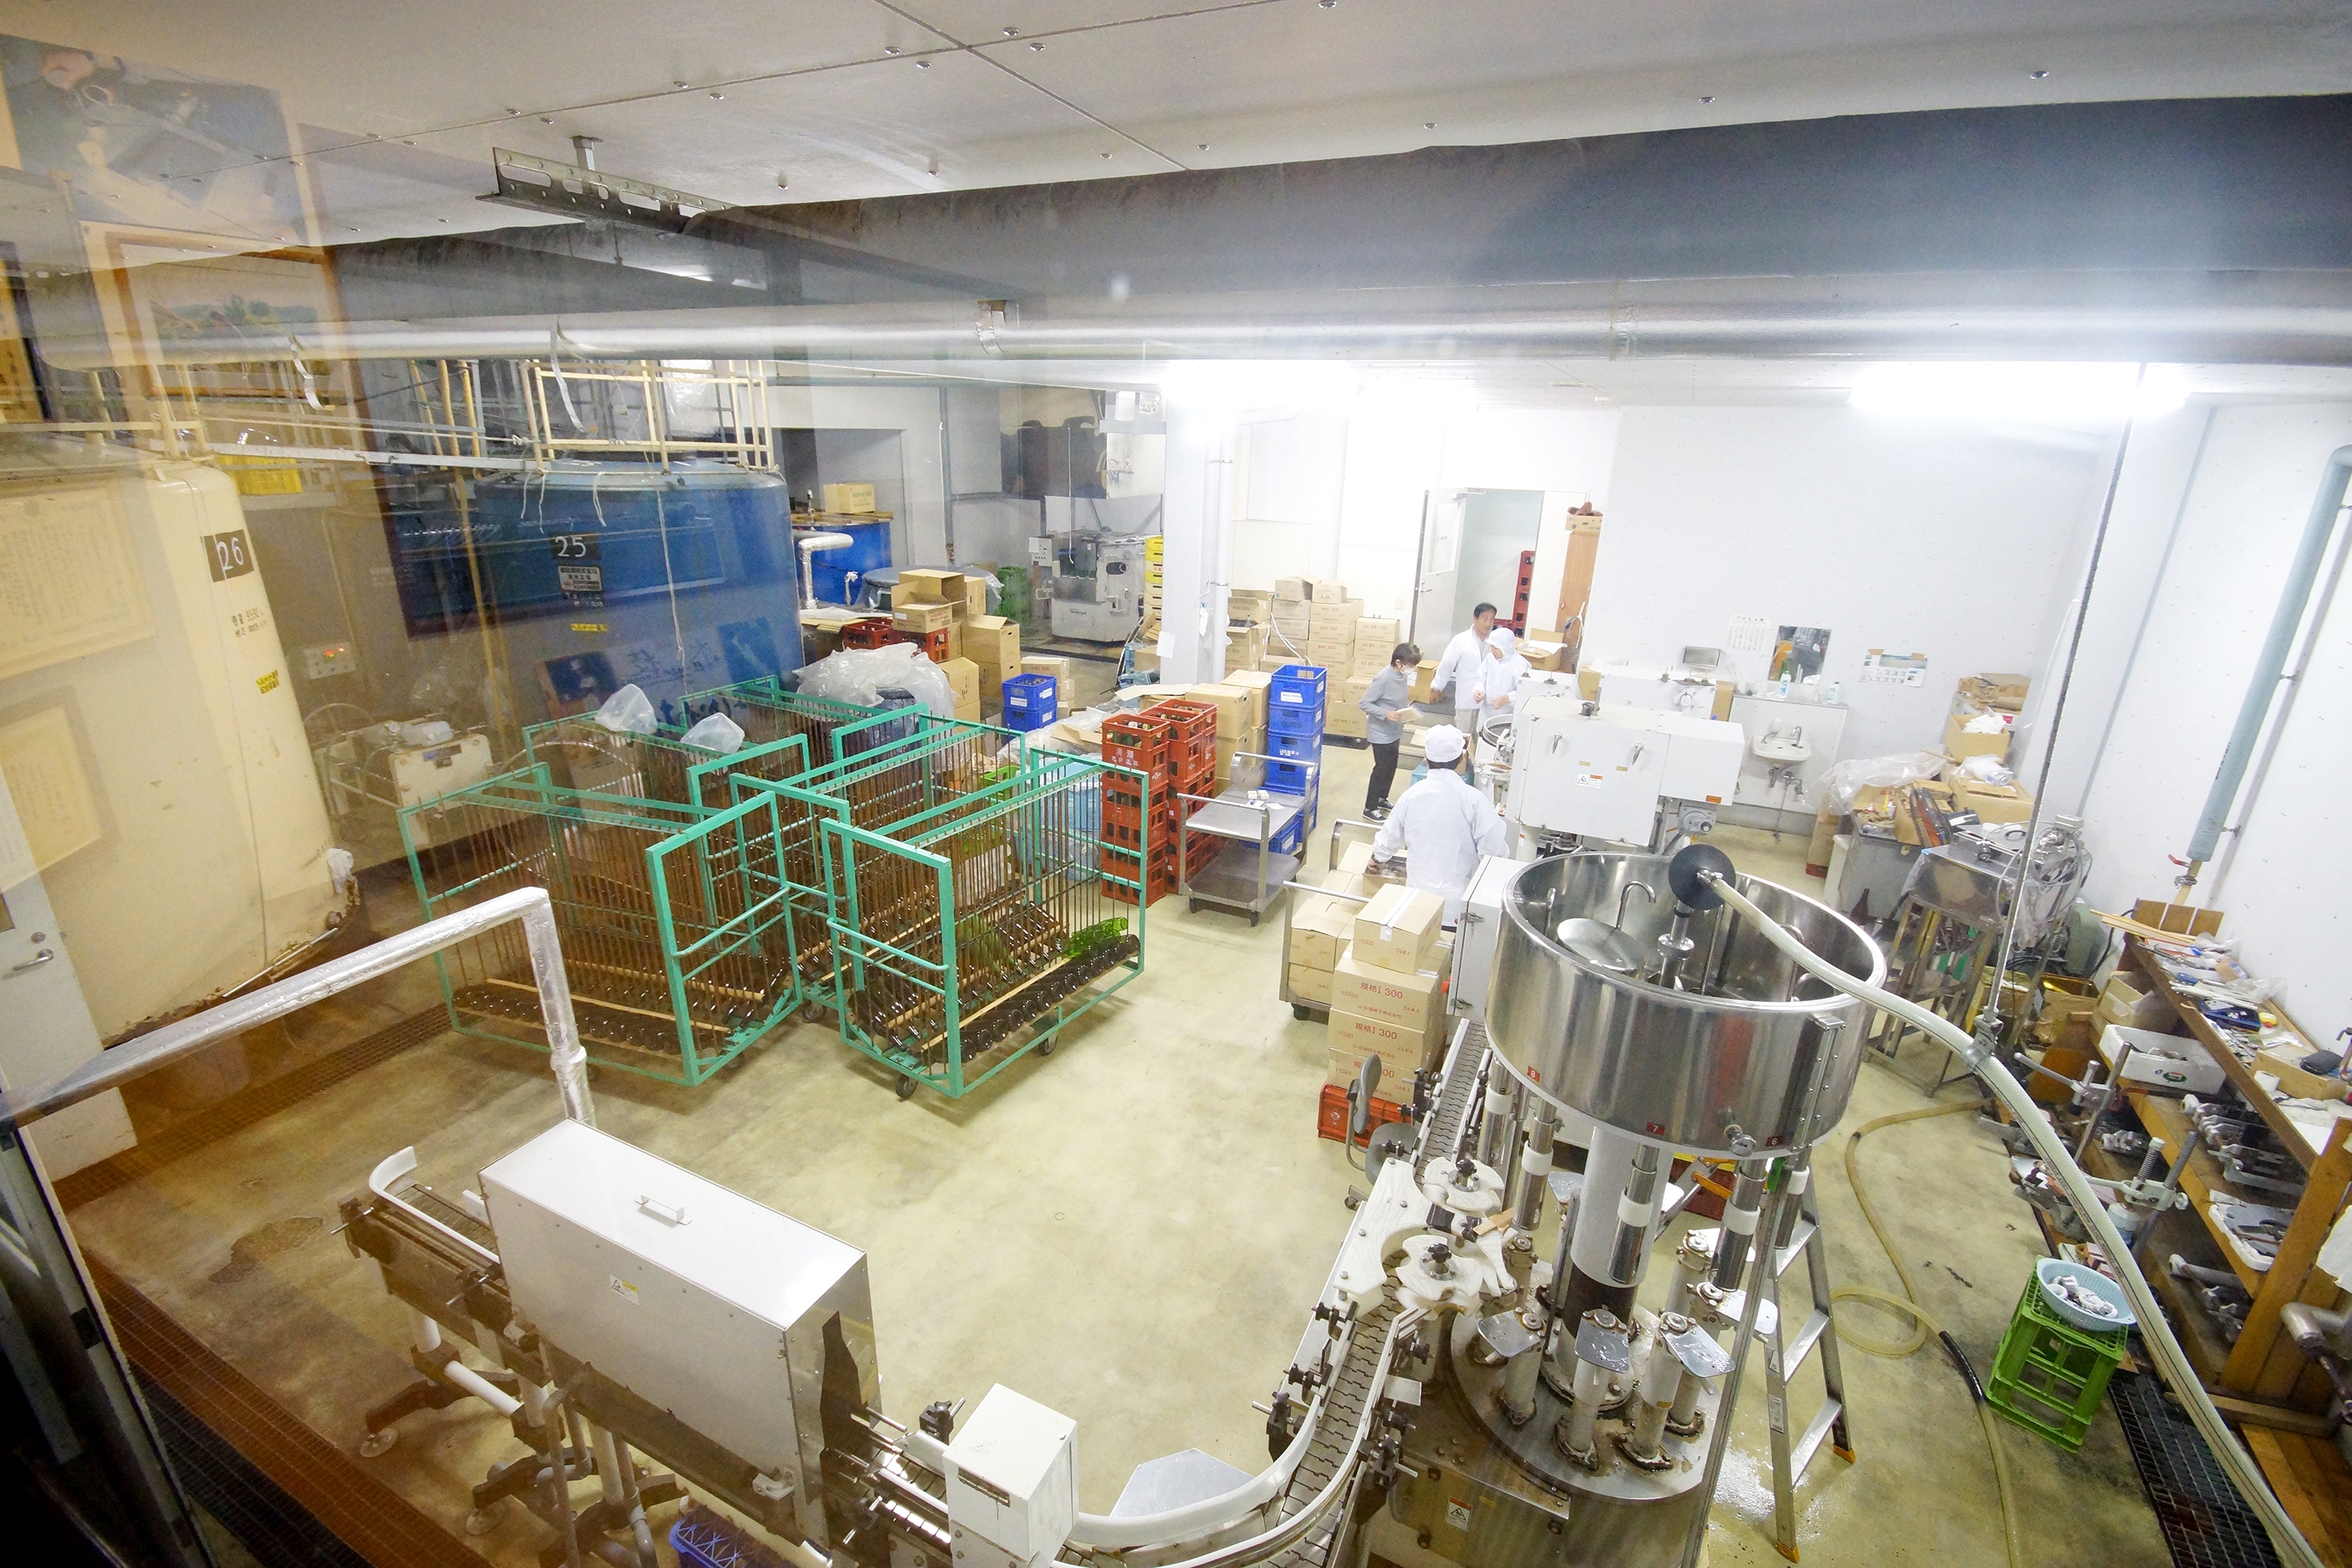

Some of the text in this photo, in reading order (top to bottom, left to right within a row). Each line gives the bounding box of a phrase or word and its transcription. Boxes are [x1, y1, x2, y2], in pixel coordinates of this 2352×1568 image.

[555, 536, 586, 557] 25
[216, 537, 244, 570] 26
[1385, 989, 1403, 999] 300
[1379, 1029, 1397, 1040] 300
[1381, 1069, 1395, 1078] 00
[1530, 1069, 1536, 1078] 8
[1653, 1124, 1659, 1133] 7
